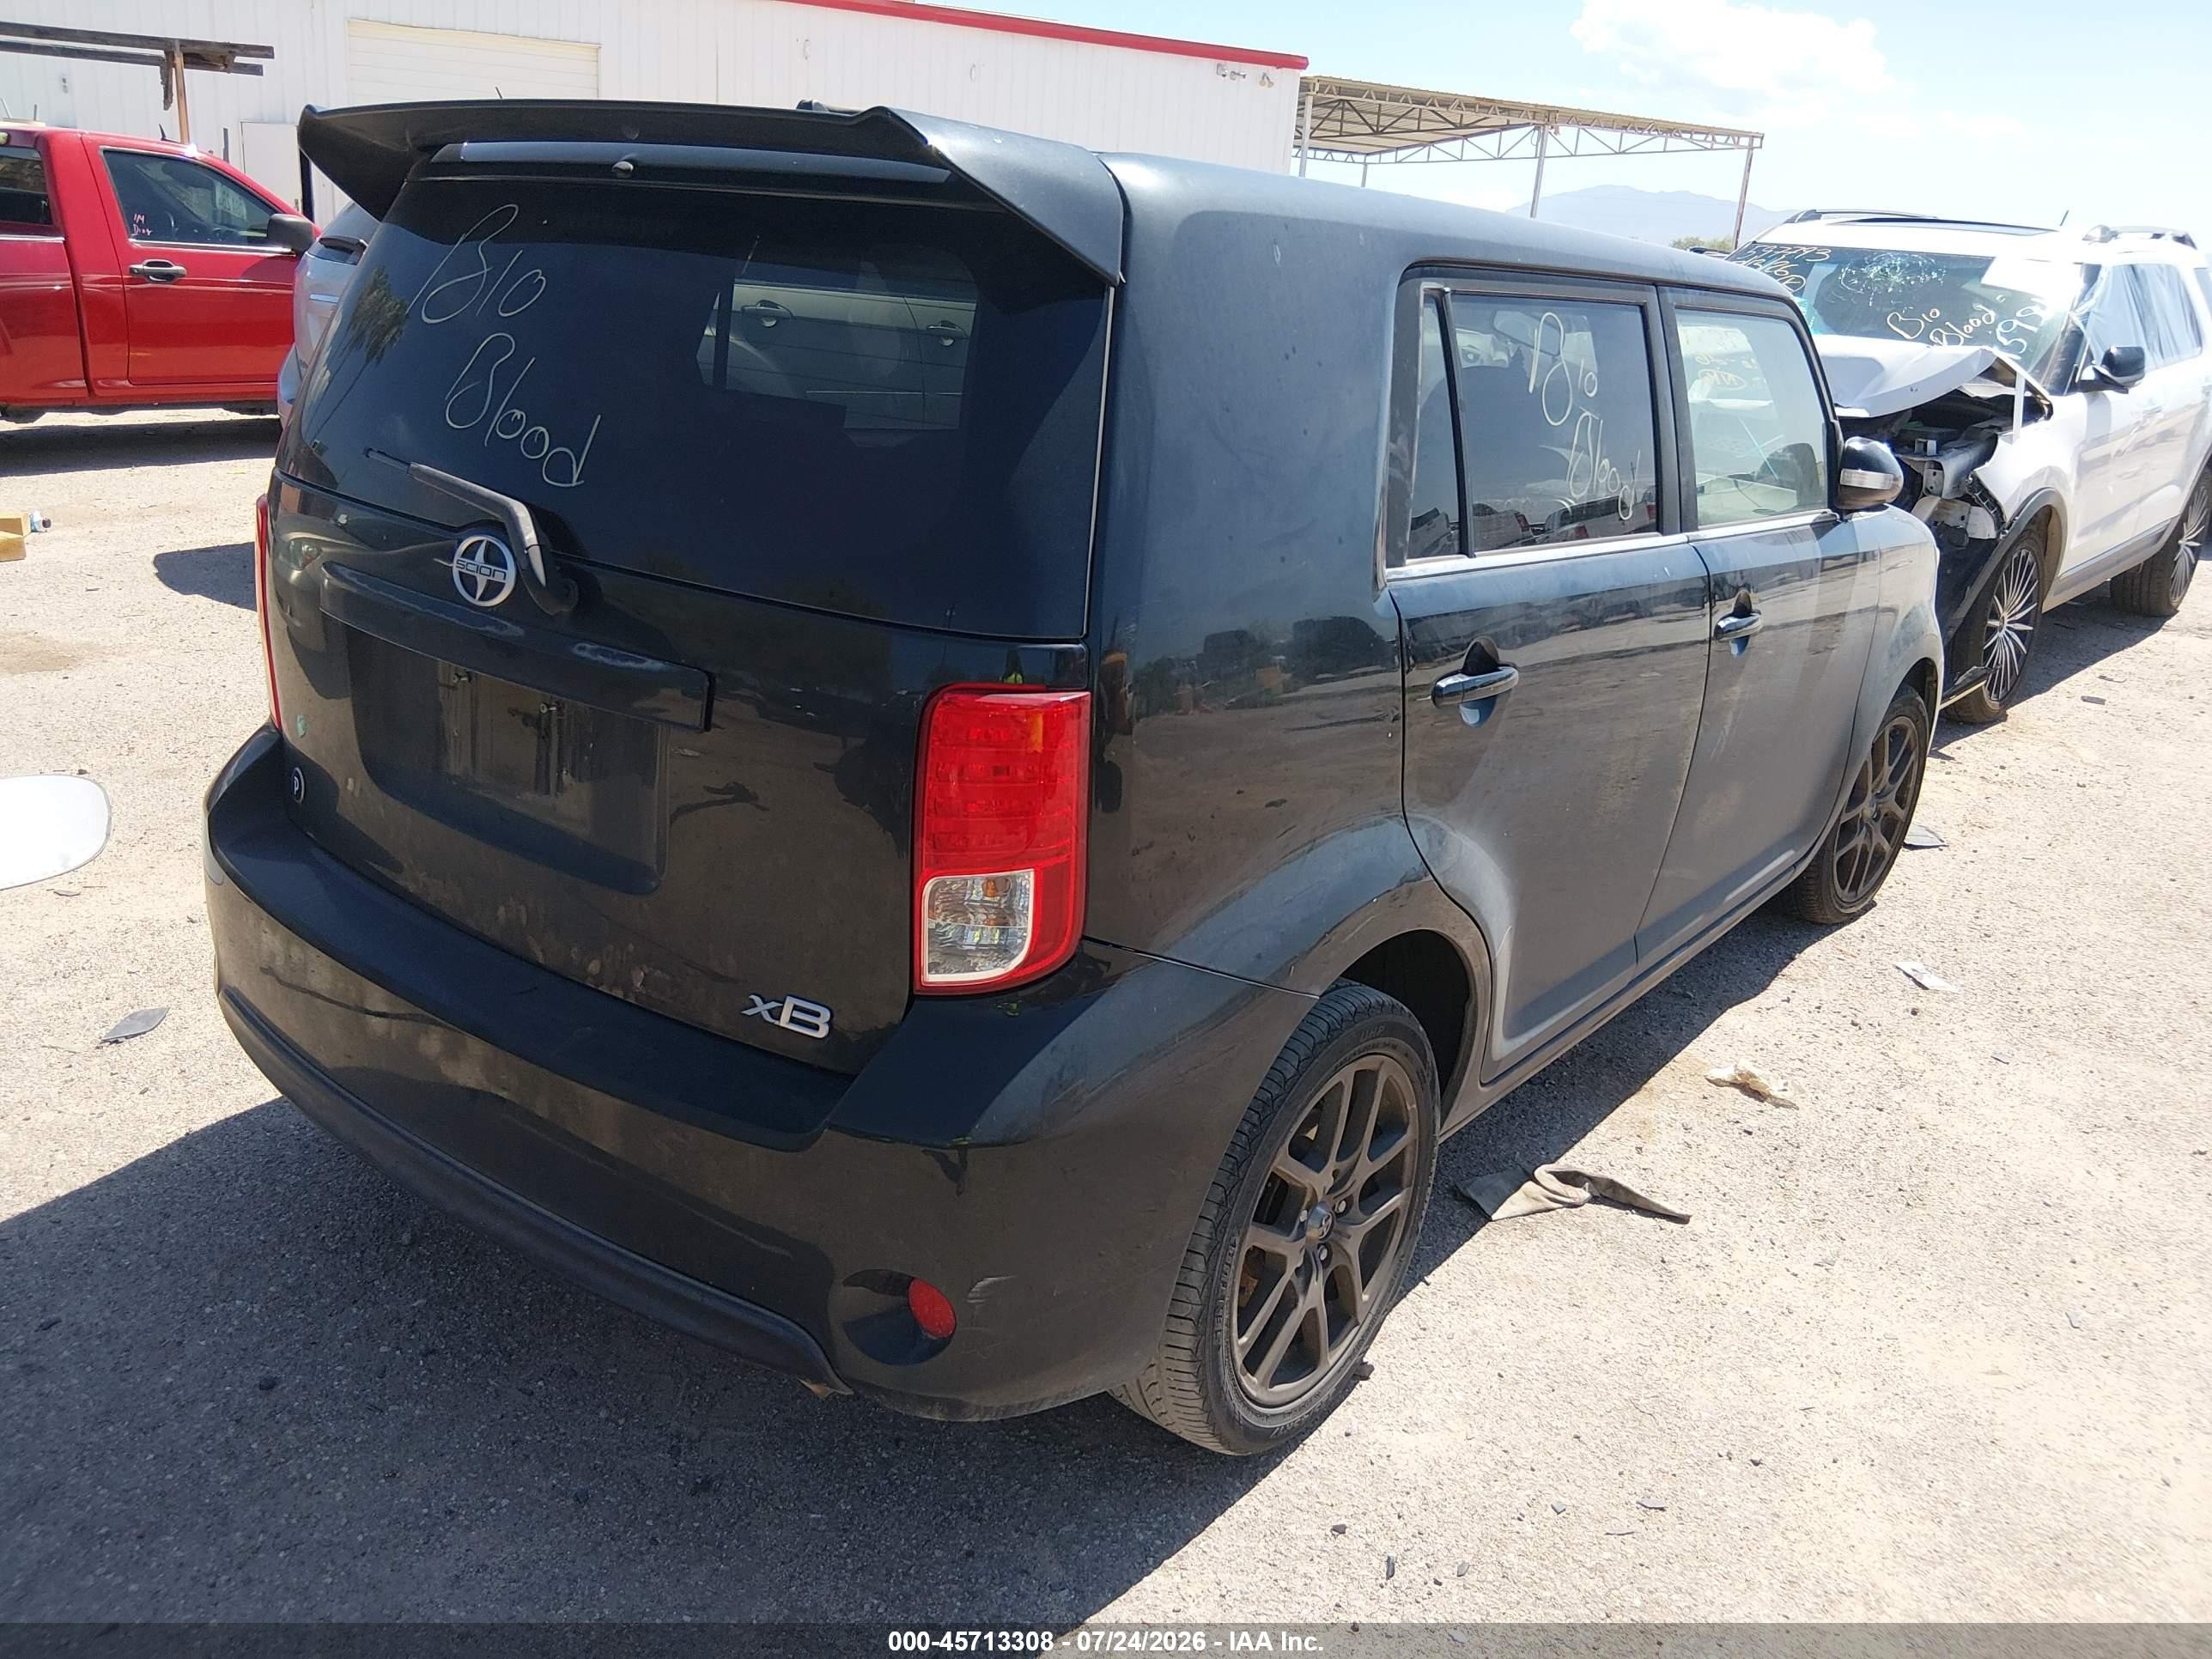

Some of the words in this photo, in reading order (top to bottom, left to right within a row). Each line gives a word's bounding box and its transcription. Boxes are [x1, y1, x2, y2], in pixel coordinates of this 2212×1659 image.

[445, 332, 601, 487] Blood
[1566, 405, 1641, 520] Blood
[741, 994, 831, 1039] xB
